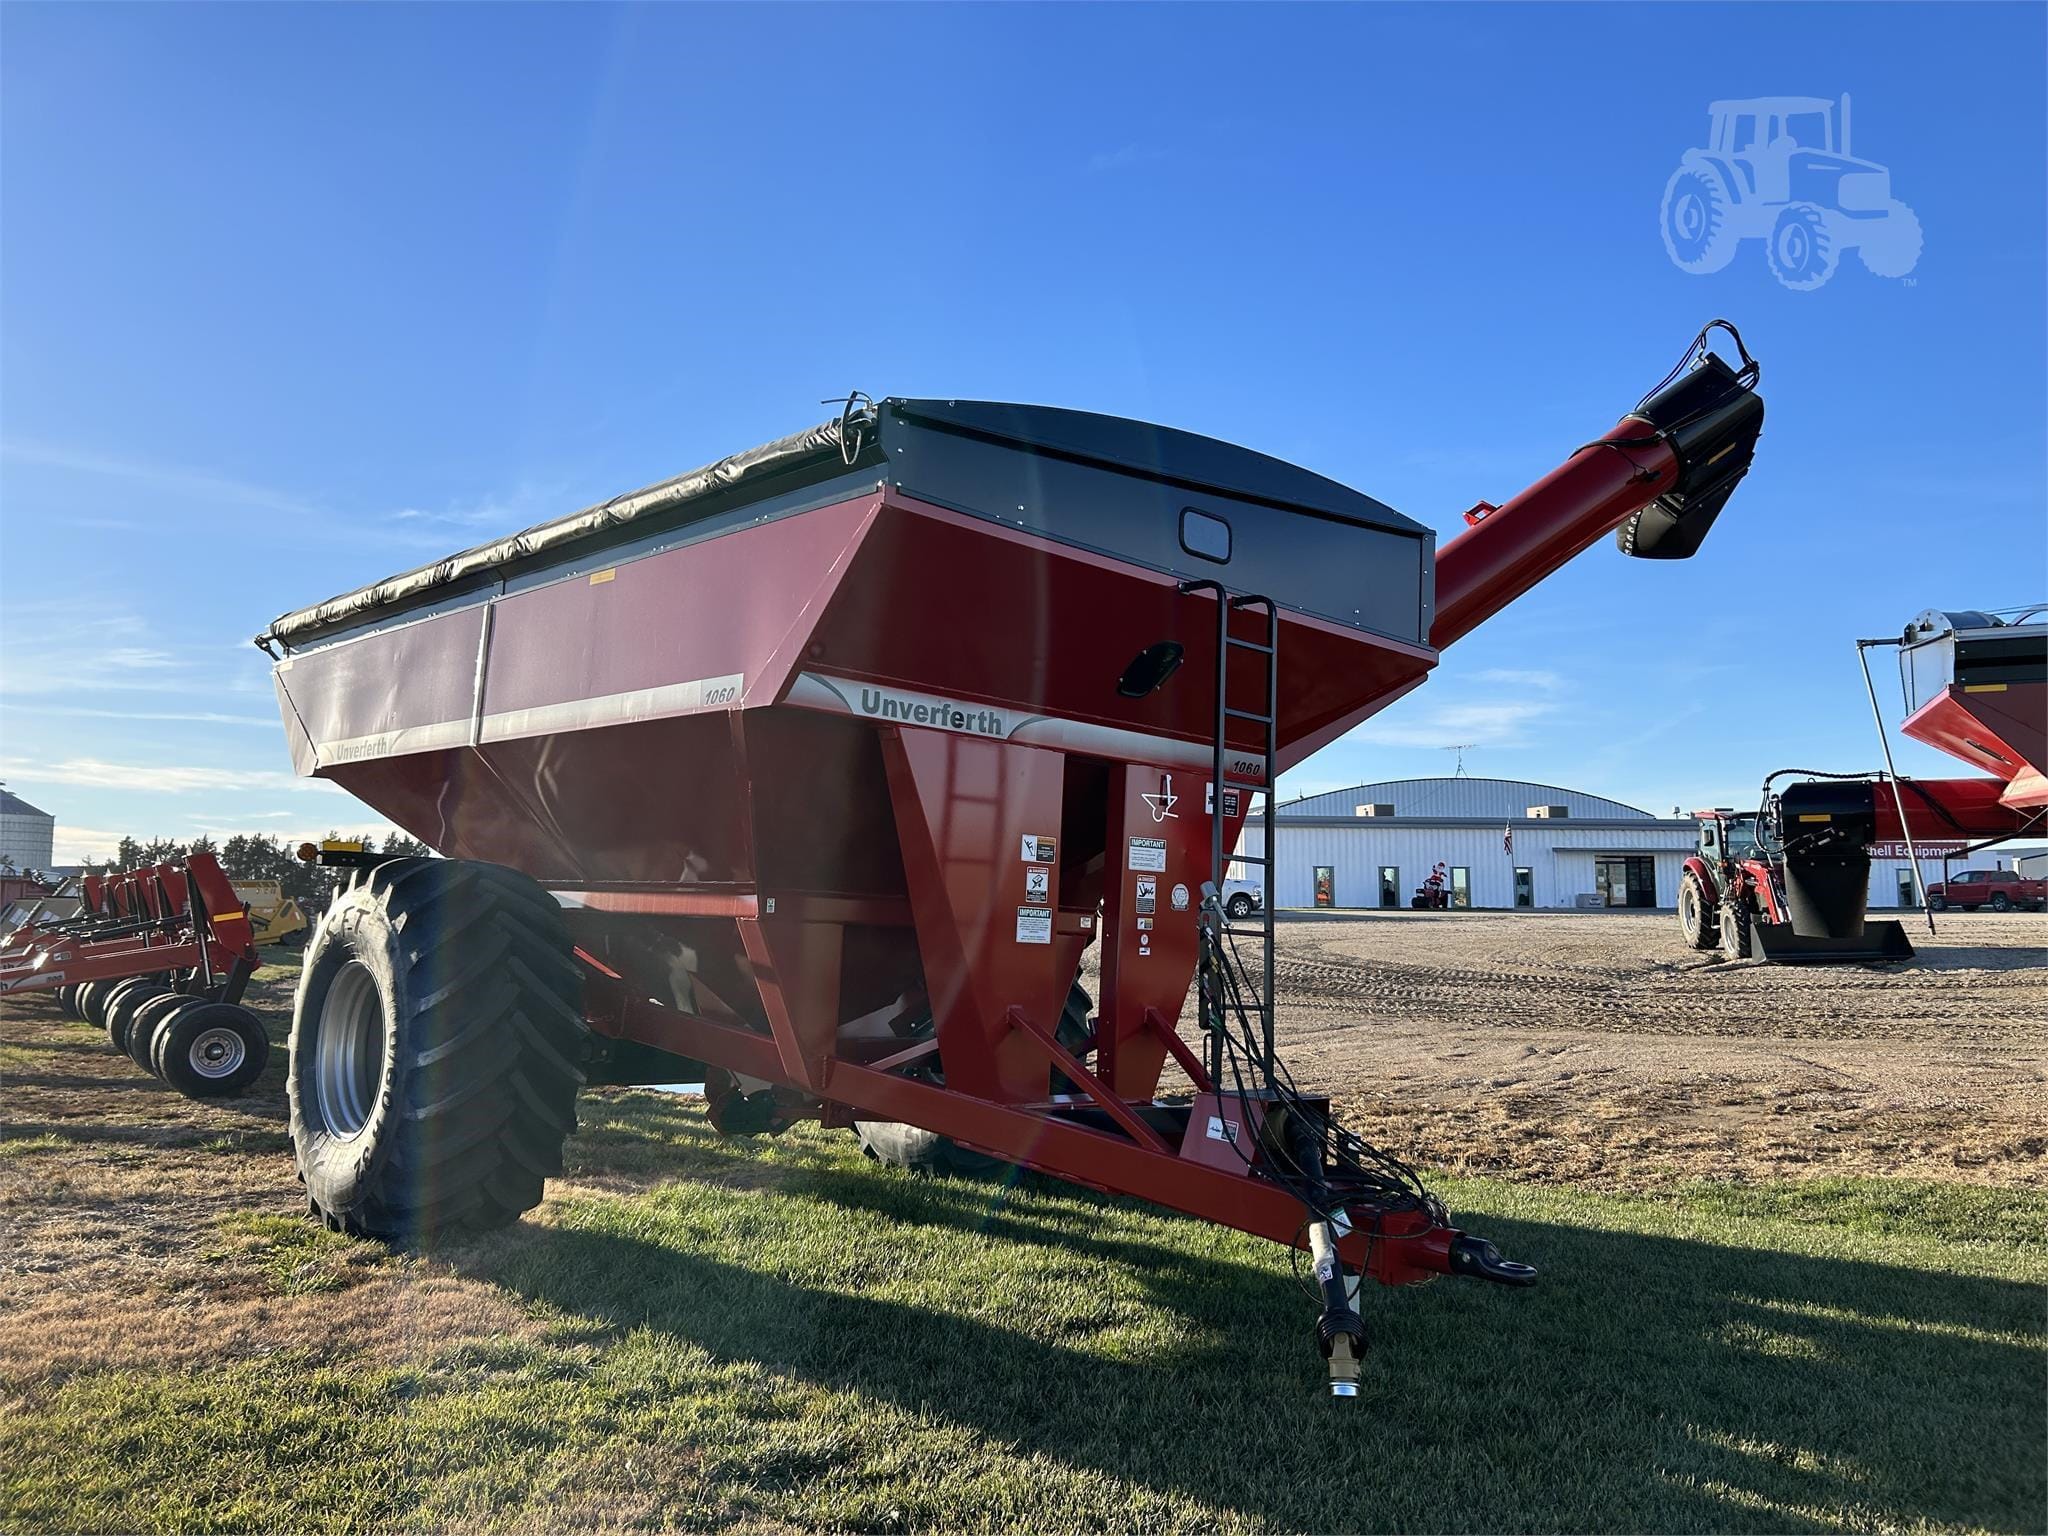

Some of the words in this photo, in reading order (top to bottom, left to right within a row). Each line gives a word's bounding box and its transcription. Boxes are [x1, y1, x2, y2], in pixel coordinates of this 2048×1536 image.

[705, 687, 735, 705] 1060
[861, 688, 1002, 736] Unverferth
[337, 737, 387, 760] Unverferth
[1232, 760, 1260, 776] 1060
[1131, 838, 1165, 849] IMPORTANT
[1019, 908, 1050, 918] IMPORTANT
